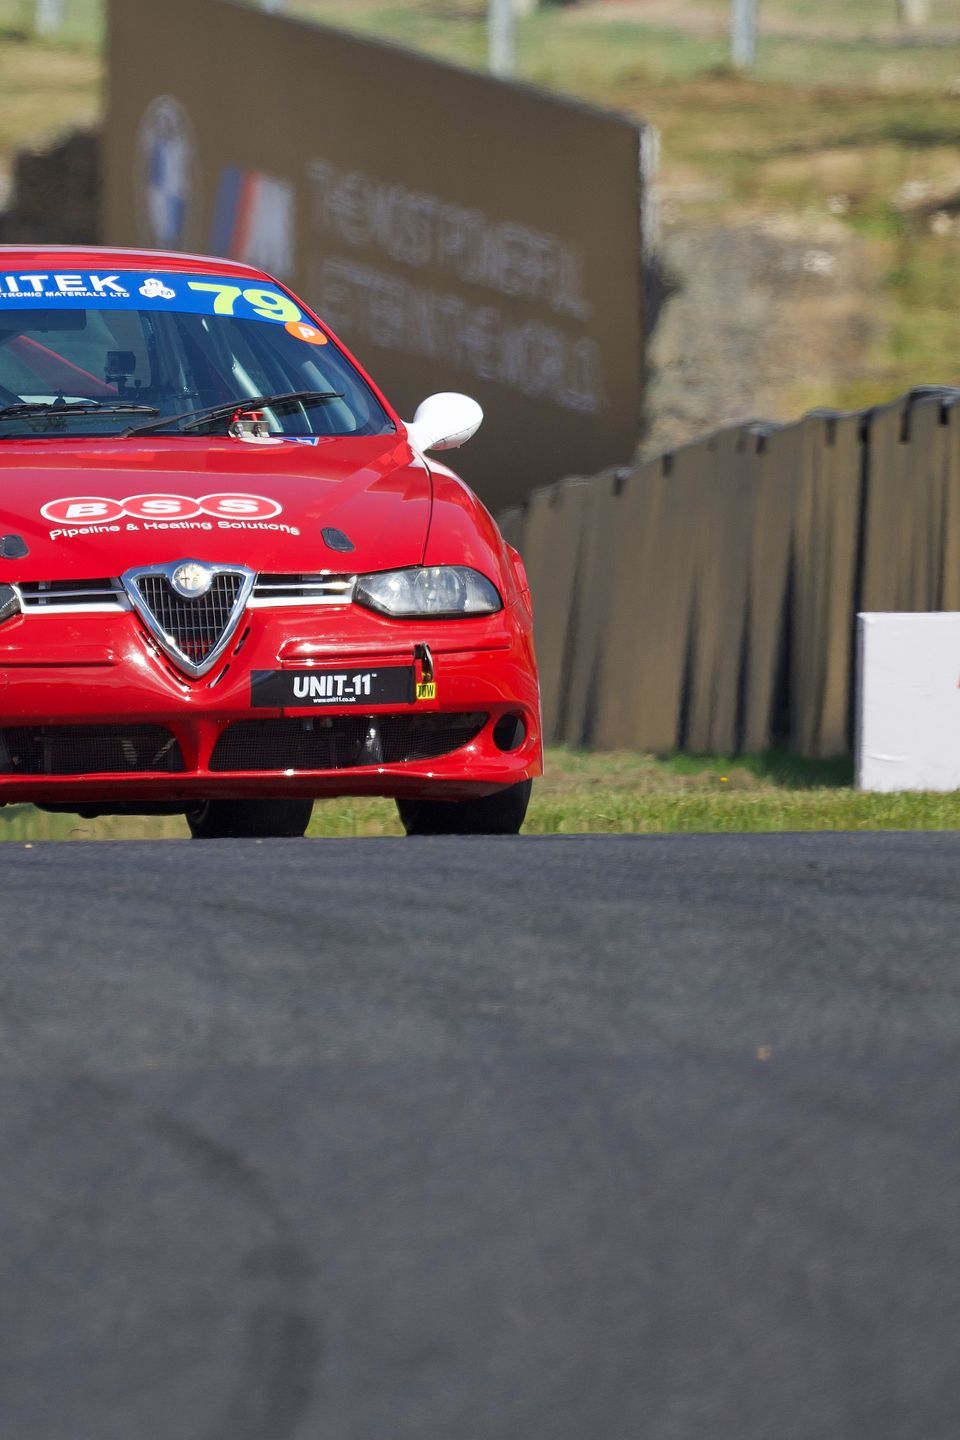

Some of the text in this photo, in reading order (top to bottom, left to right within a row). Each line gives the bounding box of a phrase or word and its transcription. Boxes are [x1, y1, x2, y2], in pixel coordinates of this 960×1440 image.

[45, 290, 107, 298] MATERIALS
[187, 281, 302, 323] 79
[60, 497, 266, 521] BSS
[49, 521, 301, 541] Pipeline & Heating Solutions
[293, 673, 371, 698] UNIT-11
